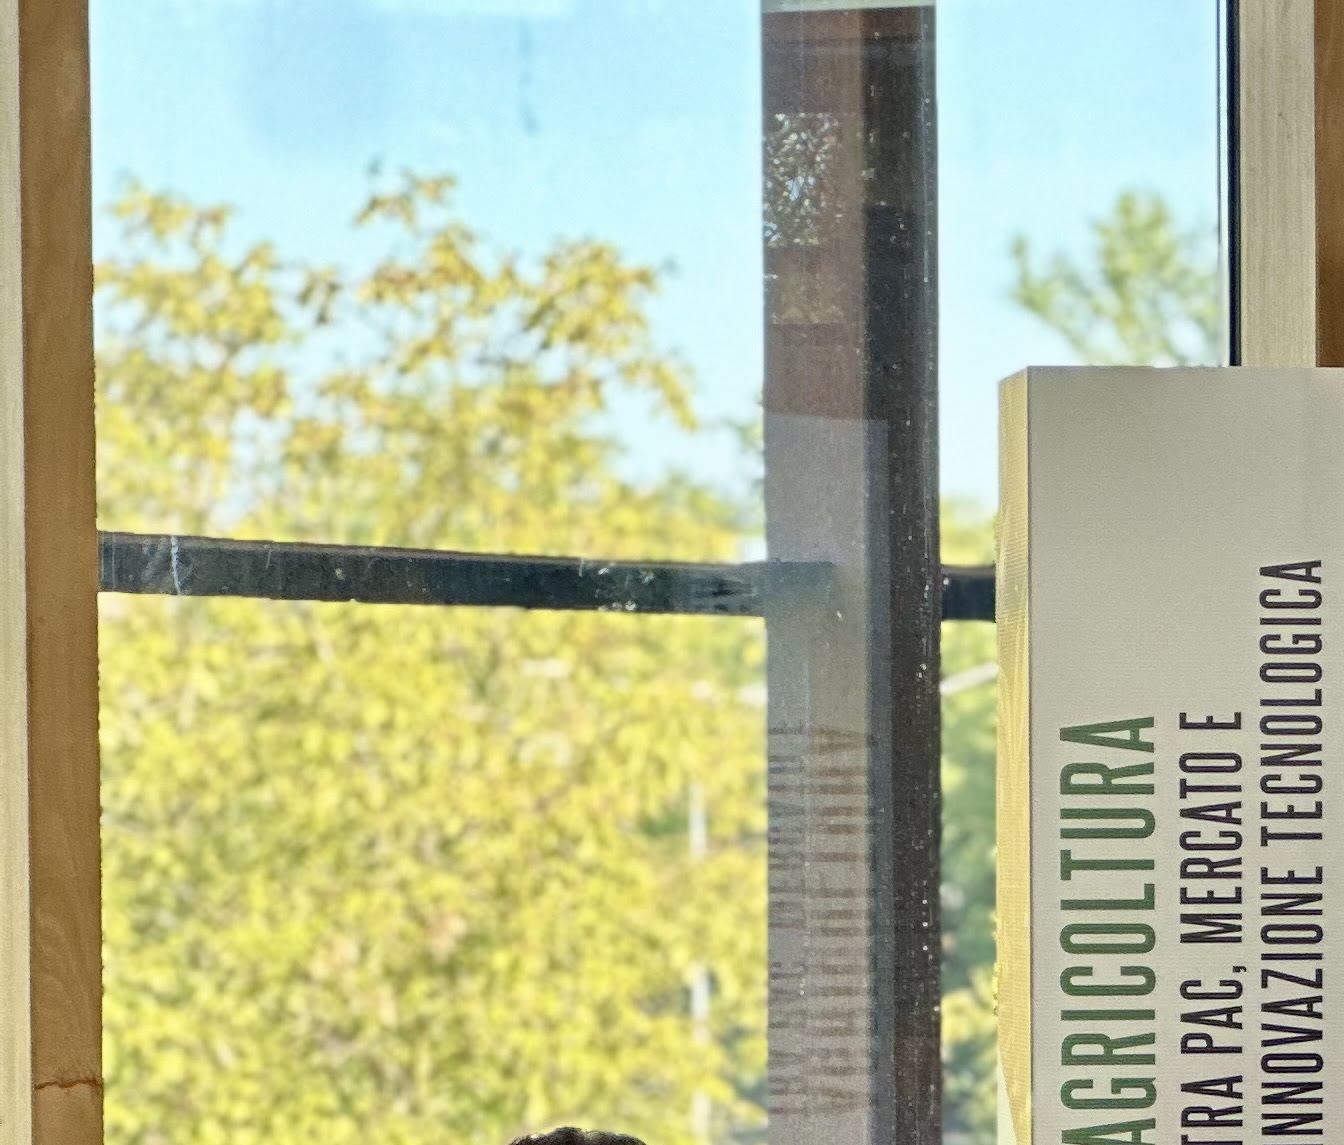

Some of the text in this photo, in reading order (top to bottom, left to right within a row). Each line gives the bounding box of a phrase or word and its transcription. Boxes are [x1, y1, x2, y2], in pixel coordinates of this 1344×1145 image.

[1179, 712, 1241, 730] E
[1259, 560, 1323, 847] TECNOLOGICA
[1179, 753, 1242, 943] MERCATO
[1180, 966, 1246, 1054] PAC,
